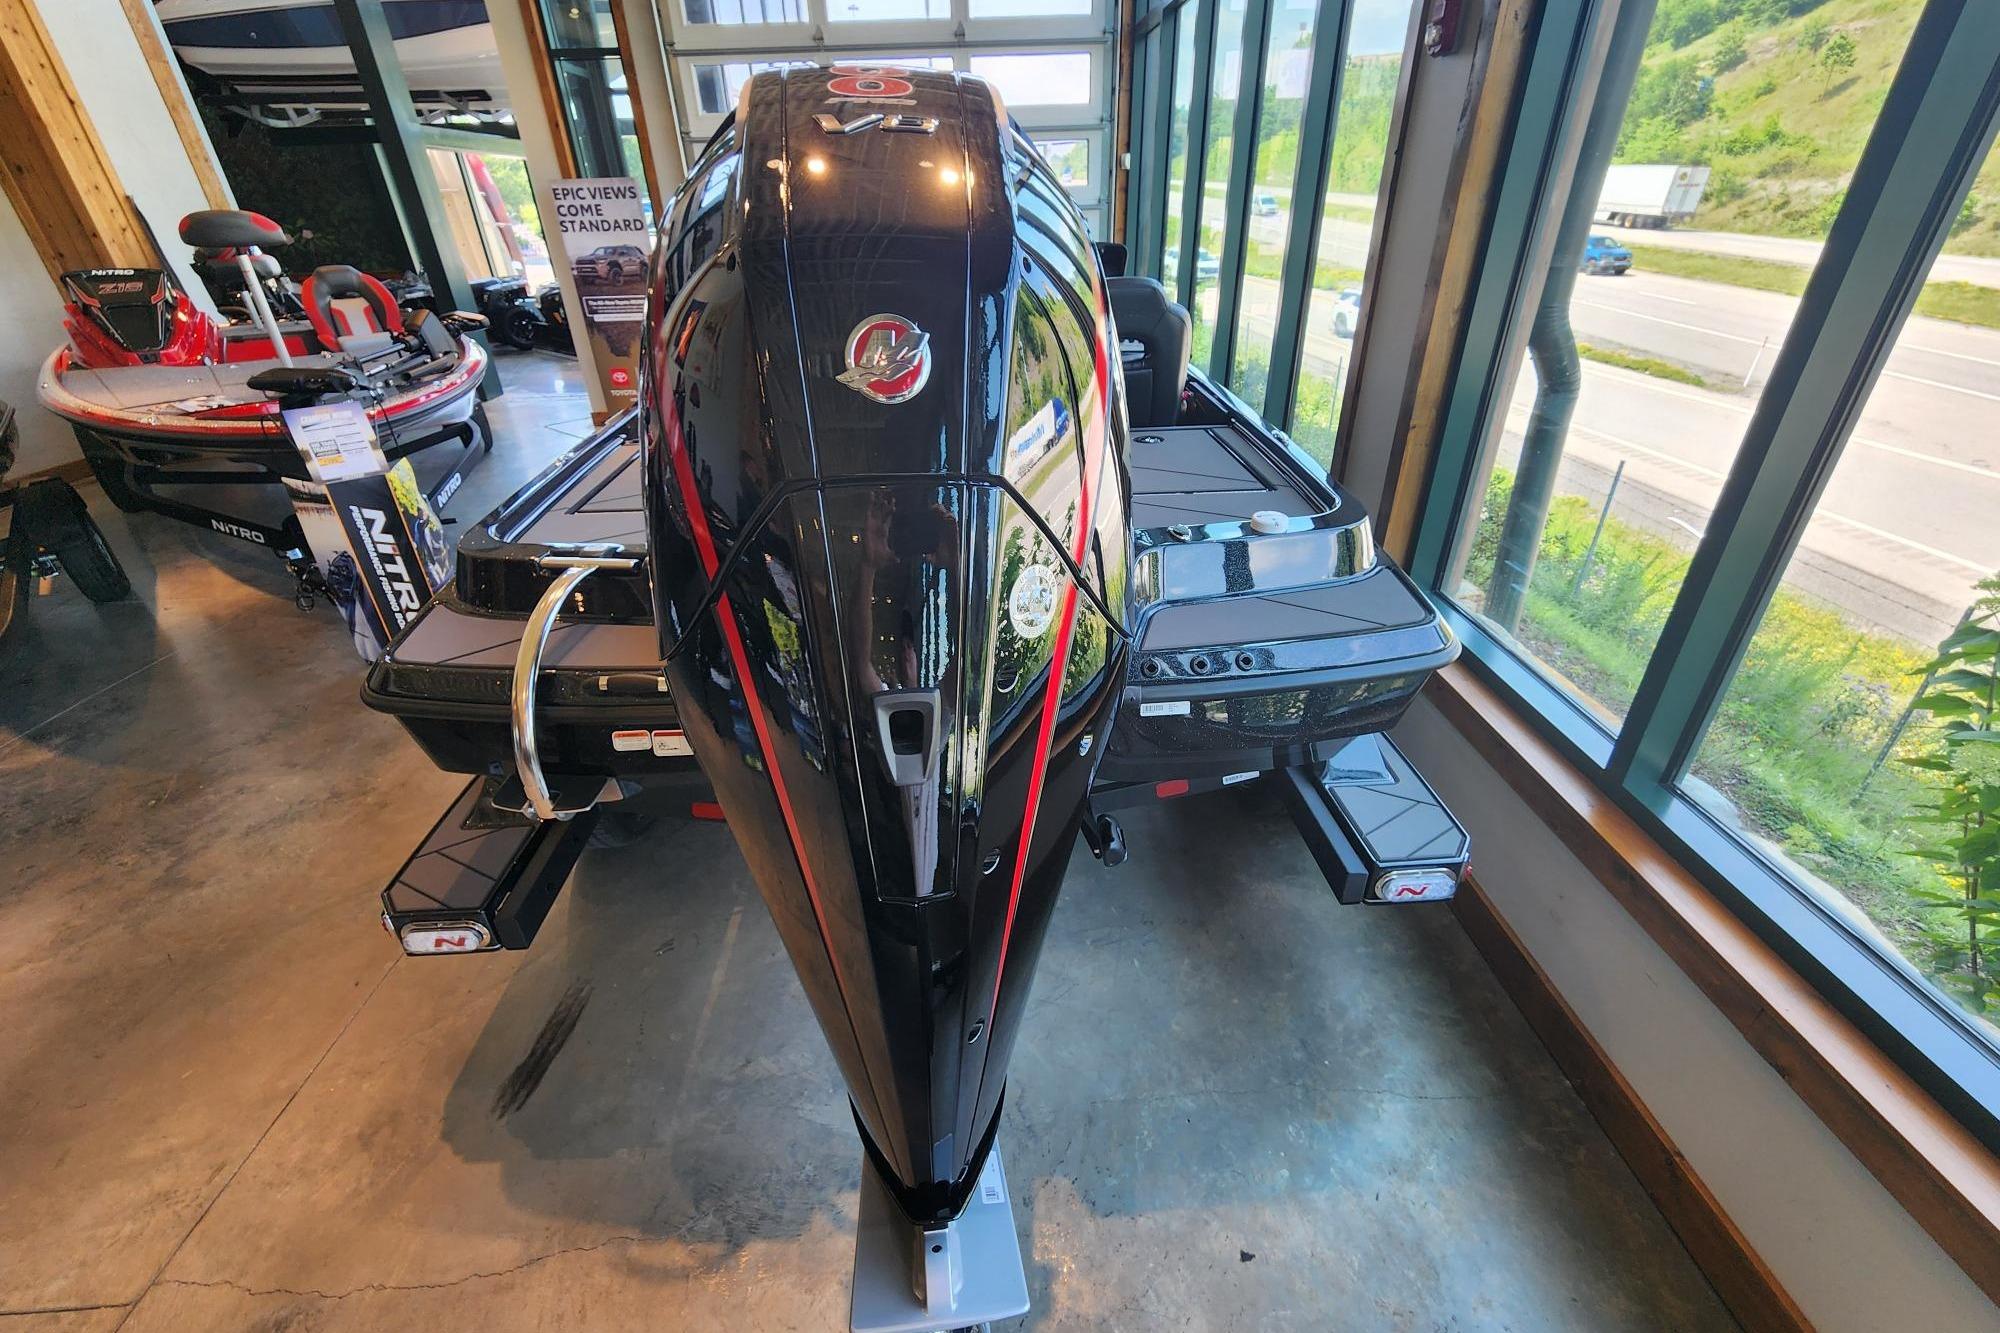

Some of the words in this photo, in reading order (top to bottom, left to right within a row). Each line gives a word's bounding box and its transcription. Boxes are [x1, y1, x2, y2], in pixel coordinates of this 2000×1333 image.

[552, 187, 586, 200] EPIC
[587, 186, 637, 200] VIEWS
[557, 204, 603, 217] COME
[560, 219, 644, 233] STANDARD
[349, 505, 385, 579] PERFORMANCE
[379, 575, 400, 612] FISHING
